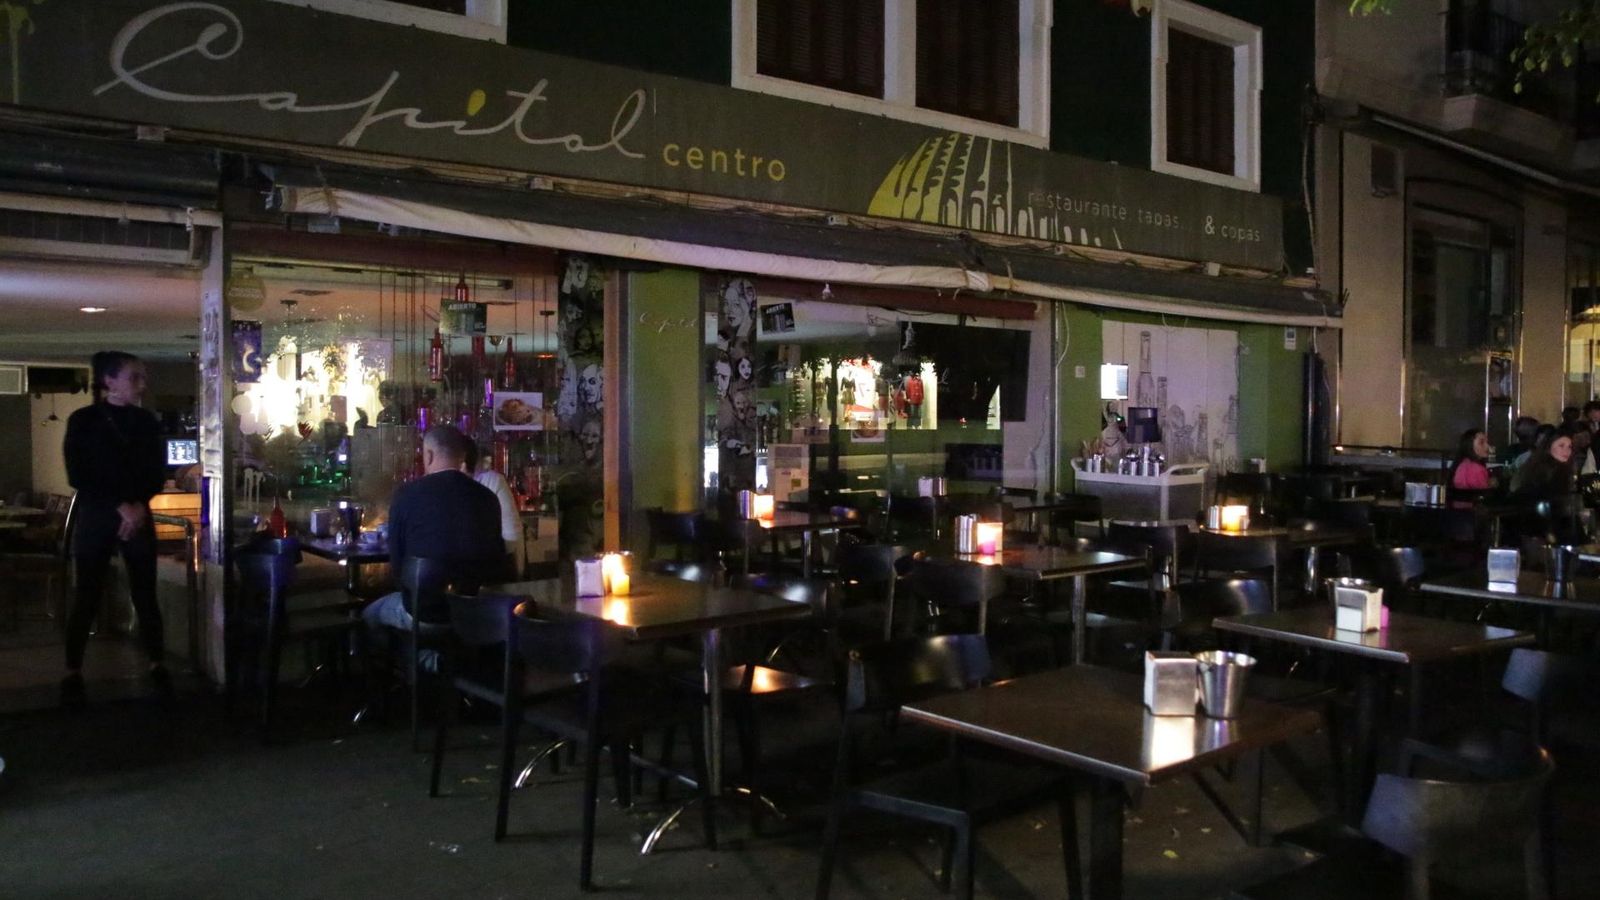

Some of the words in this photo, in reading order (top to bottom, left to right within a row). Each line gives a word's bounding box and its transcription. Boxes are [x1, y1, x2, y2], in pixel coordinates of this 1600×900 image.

[93, 2, 648, 160] Capitol
[662, 143, 786, 182] centro
[1204, 214, 1215, 236] &
[1221, 223, 1261, 243] copas
